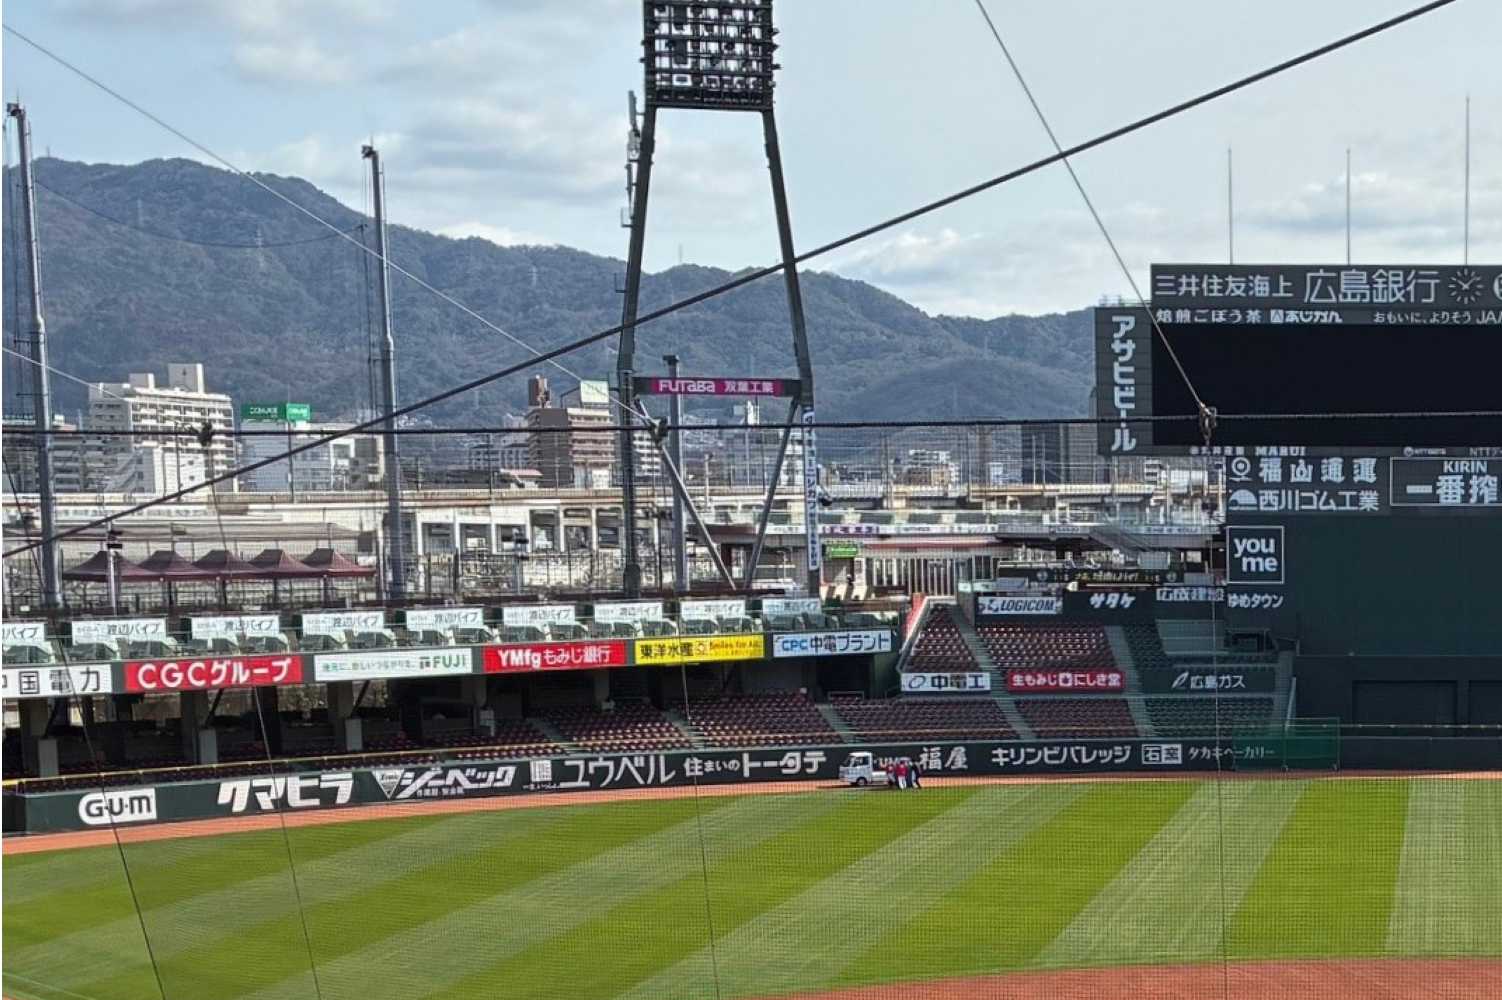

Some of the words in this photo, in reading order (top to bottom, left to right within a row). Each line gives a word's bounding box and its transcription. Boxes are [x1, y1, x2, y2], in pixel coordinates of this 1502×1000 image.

[1154, 274, 1293, 297] 三井住友海上
[1303, 268, 1441, 304] 広島銀行
[1155, 308, 1263, 324] 焙煎ごぼう茶
[1110, 315, 1137, 451] アサヒビール
[1258, 457, 1377, 483] 福山通運
[1443, 460, 1488, 473] KIRIN
[1258, 489, 1379, 511] 西川ゴム工業
[1233, 537, 1275, 558] you
[1241, 556, 1278, 572] me
[1001, 599, 1056, 612] LOGICOM
[1090, 592, 1136, 608] サタケ
[1227, 593, 1284, 608] ゆめタウン
[2, 627, 39, 640] パイプ
[809, 634, 890, 653] 中電プラント
[498, 650, 542, 667] YMfg
[543, 646, 612, 664] もみじ銀行
[640, 642, 695, 659] 東洋水産
[433, 655, 467, 669] FUJI
[138, 657, 292, 689] CGCグループ
[1012, 673, 1057, 686] 生もみじ
[1190, 674, 1246, 688] 広島ガス
[919, 746, 969, 771] 福屋
[991, 744, 1132, 766] キリンビバレッジ
[559, 754, 676, 787] ユウベル
[397, 765, 518, 799] ジーベック
[217, 773, 355, 813] クマヒラ
